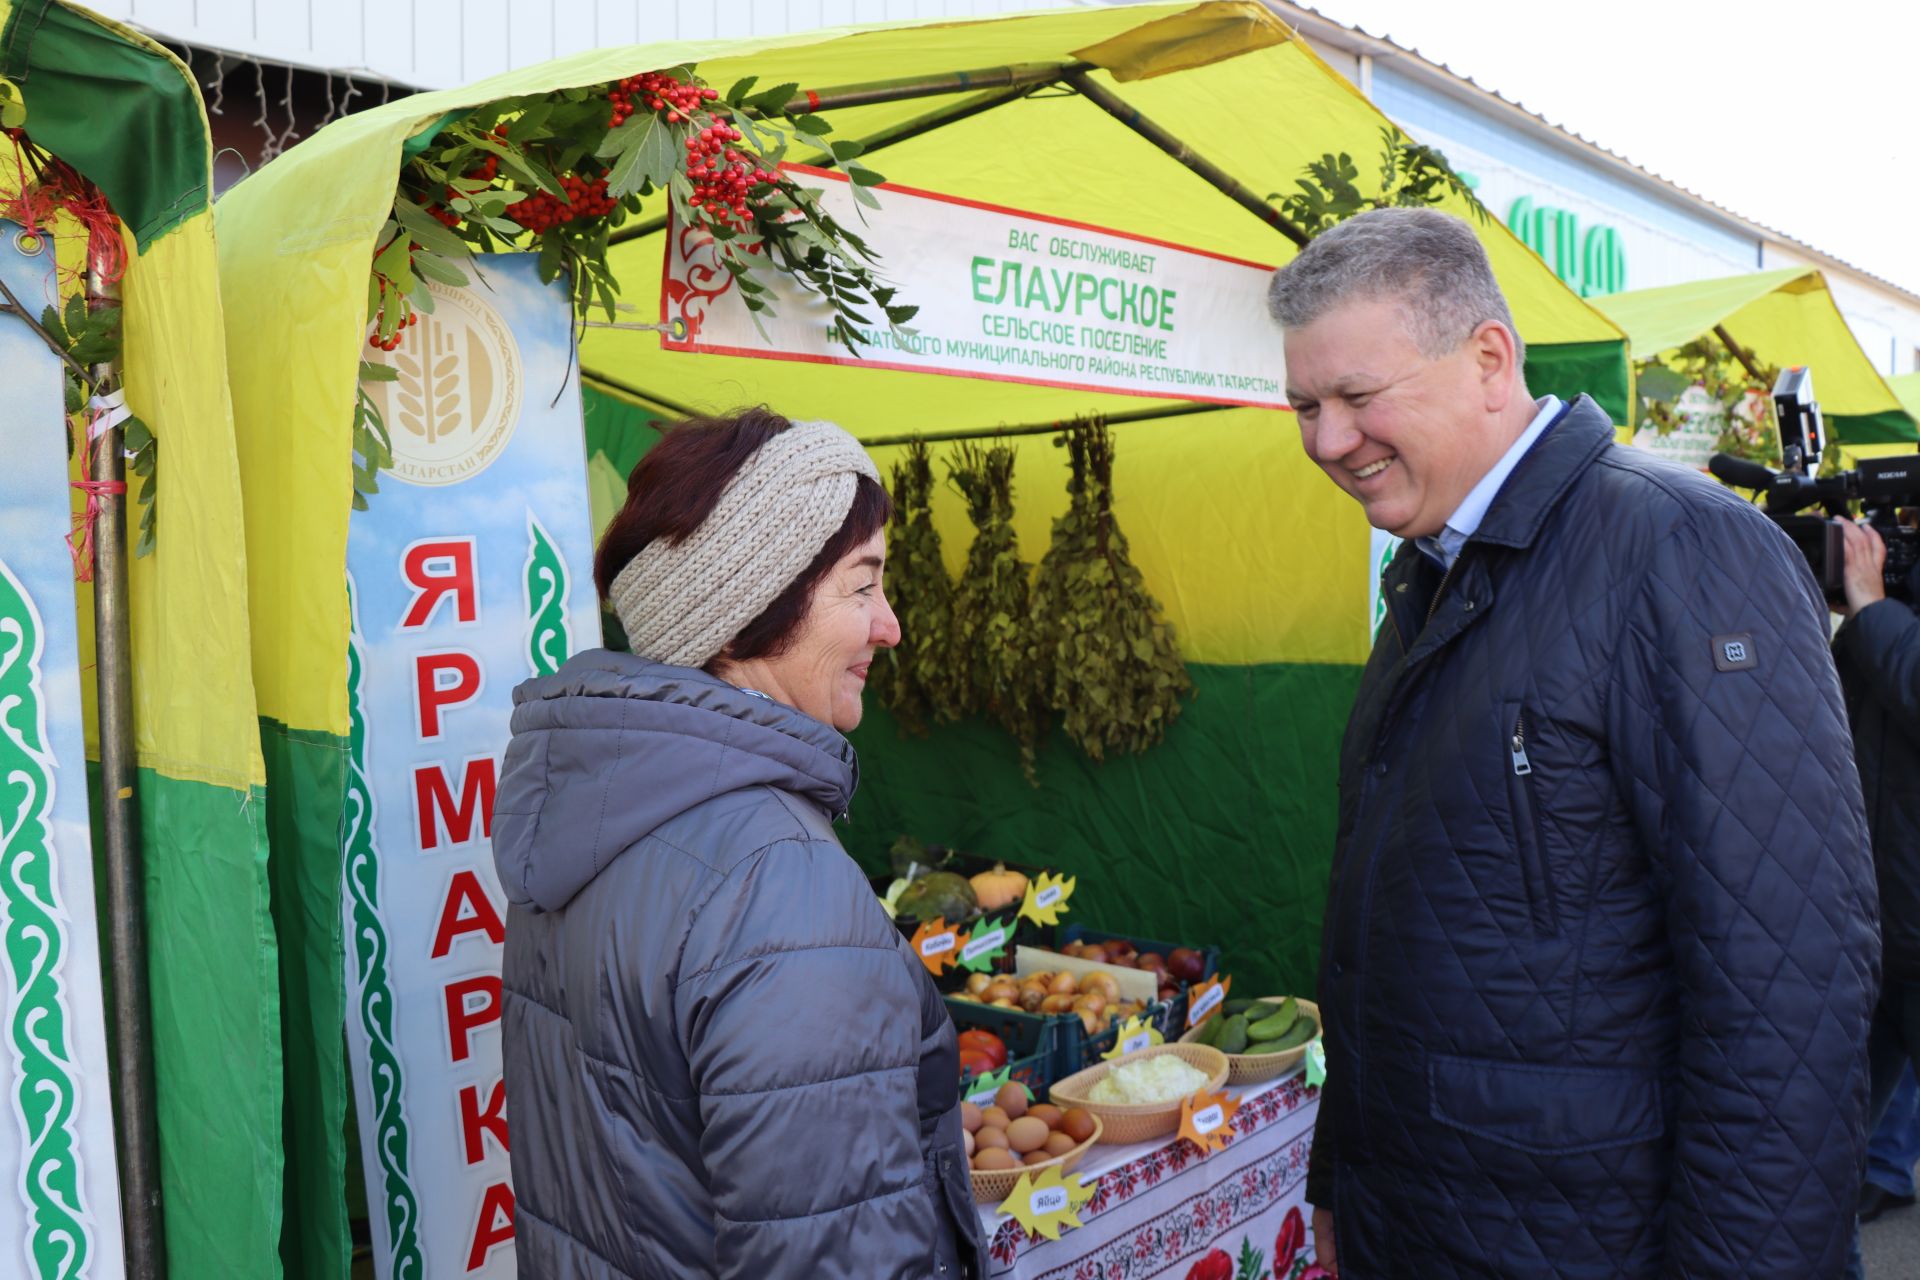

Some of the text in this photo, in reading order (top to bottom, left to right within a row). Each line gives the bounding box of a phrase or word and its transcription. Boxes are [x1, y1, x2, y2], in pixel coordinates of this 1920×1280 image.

[1008, 228, 1157, 274] ВАС ОБСЛУЖИВАЕТ
[970, 255, 1177, 331] ЕЛАУРСКОЕ
[982, 313, 1168, 360] СЕЛЬСКОЕ ПОСЕЛЕНИЕ
[946, 339, 1085, 372] МУНИЦИПАЛЬНОГО
[1088, 355, 1137, 379] РАЙОНА
[1140, 364, 1217, 388] РЕСПУБЛИКИ
[1217, 373, 1279, 394] ТАТАРСТАН
[392, 456, 476, 479] АТАРСТАН
[402, 540, 516, 1272] ЯРМАРКА
